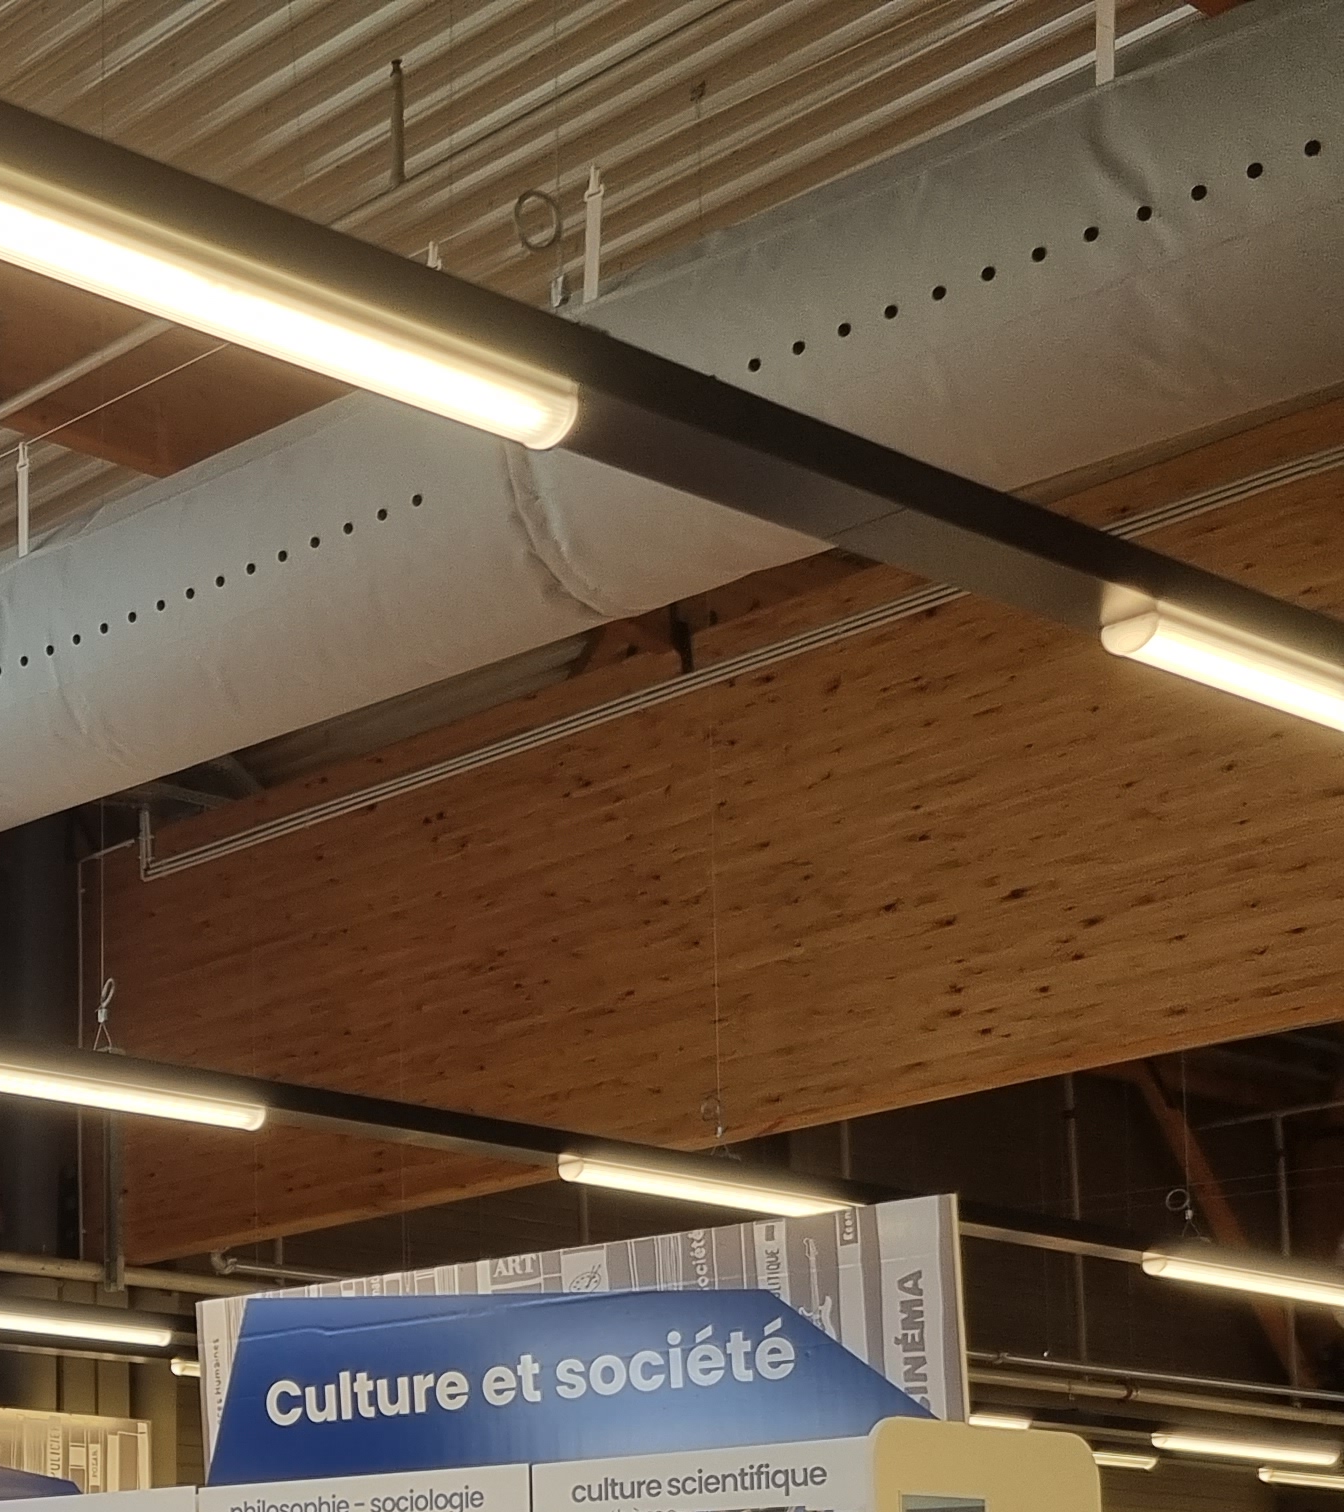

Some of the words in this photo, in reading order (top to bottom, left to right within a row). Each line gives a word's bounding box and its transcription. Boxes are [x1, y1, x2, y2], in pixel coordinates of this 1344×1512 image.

[494, 1254, 537, 1278] ART
[266, 1370, 470, 1427] Culture
[482, 1354, 542, 1407] et
[555, 1316, 796, 1400] société
[571, 1475, 663, 1504] culture
[667, 1462, 829, 1497] scientifique
